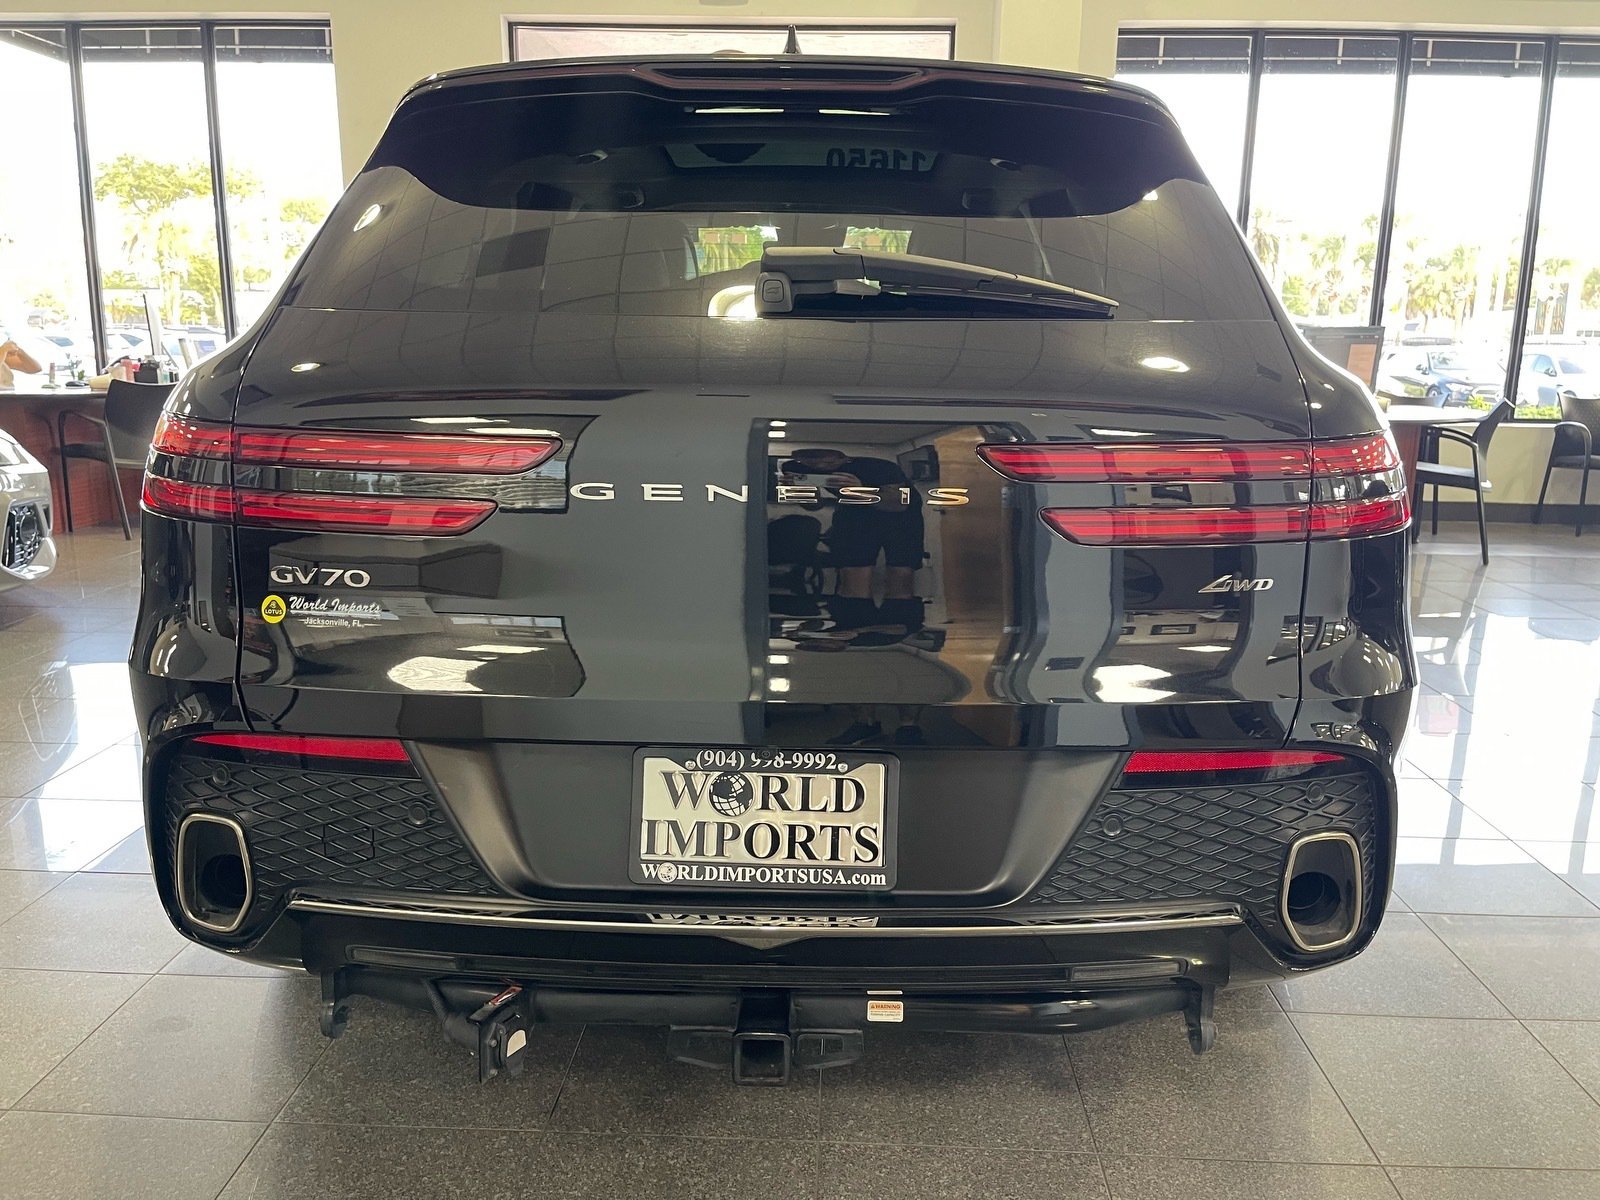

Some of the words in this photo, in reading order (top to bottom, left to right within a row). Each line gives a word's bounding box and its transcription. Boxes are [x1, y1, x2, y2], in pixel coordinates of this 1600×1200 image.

[569, 481, 970, 506] GENESIS
[270, 565, 371, 588] GV70
[1198, 574, 1274, 593] 4WD
[289, 596, 329, 610] World
[331, 598, 382, 613] Imports
[304, 617, 351, 628] Jacksonville,
[696, 750, 745, 771] (904)
[643, 819, 880, 863] IMPORTS
